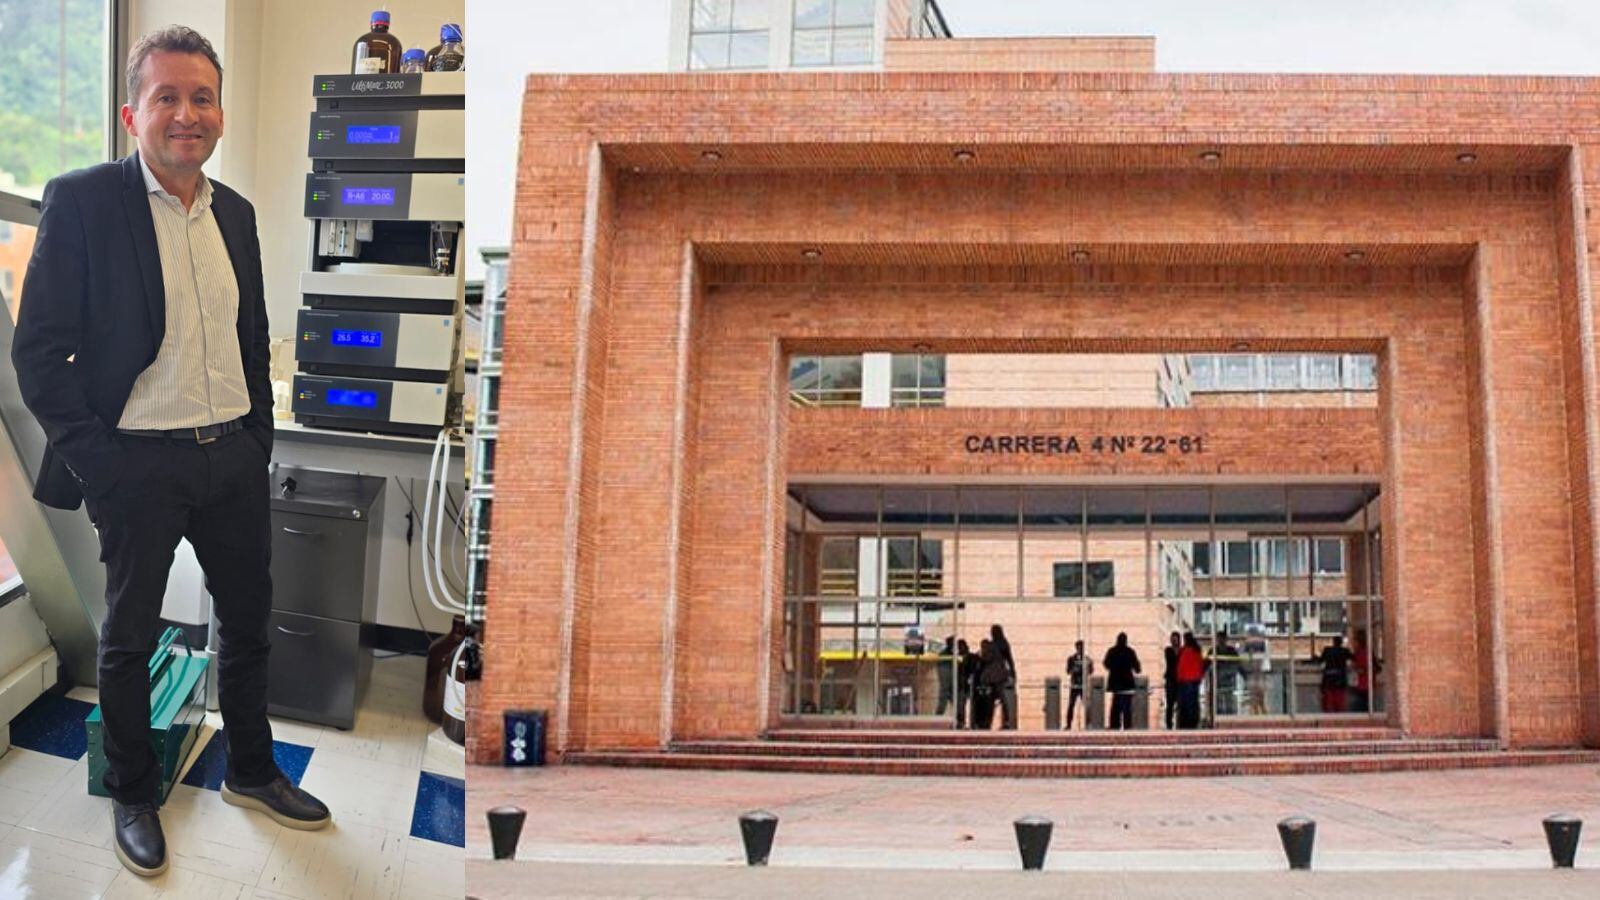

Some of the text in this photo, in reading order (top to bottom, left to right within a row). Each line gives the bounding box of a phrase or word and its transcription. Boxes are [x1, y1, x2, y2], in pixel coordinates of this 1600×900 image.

[385, 80, 405, 90] 3000
[965, 435, 1080, 453] CARRERA
[1091, 436, 1104, 453] 4
[1141, 435, 1203, 453] 22-61
